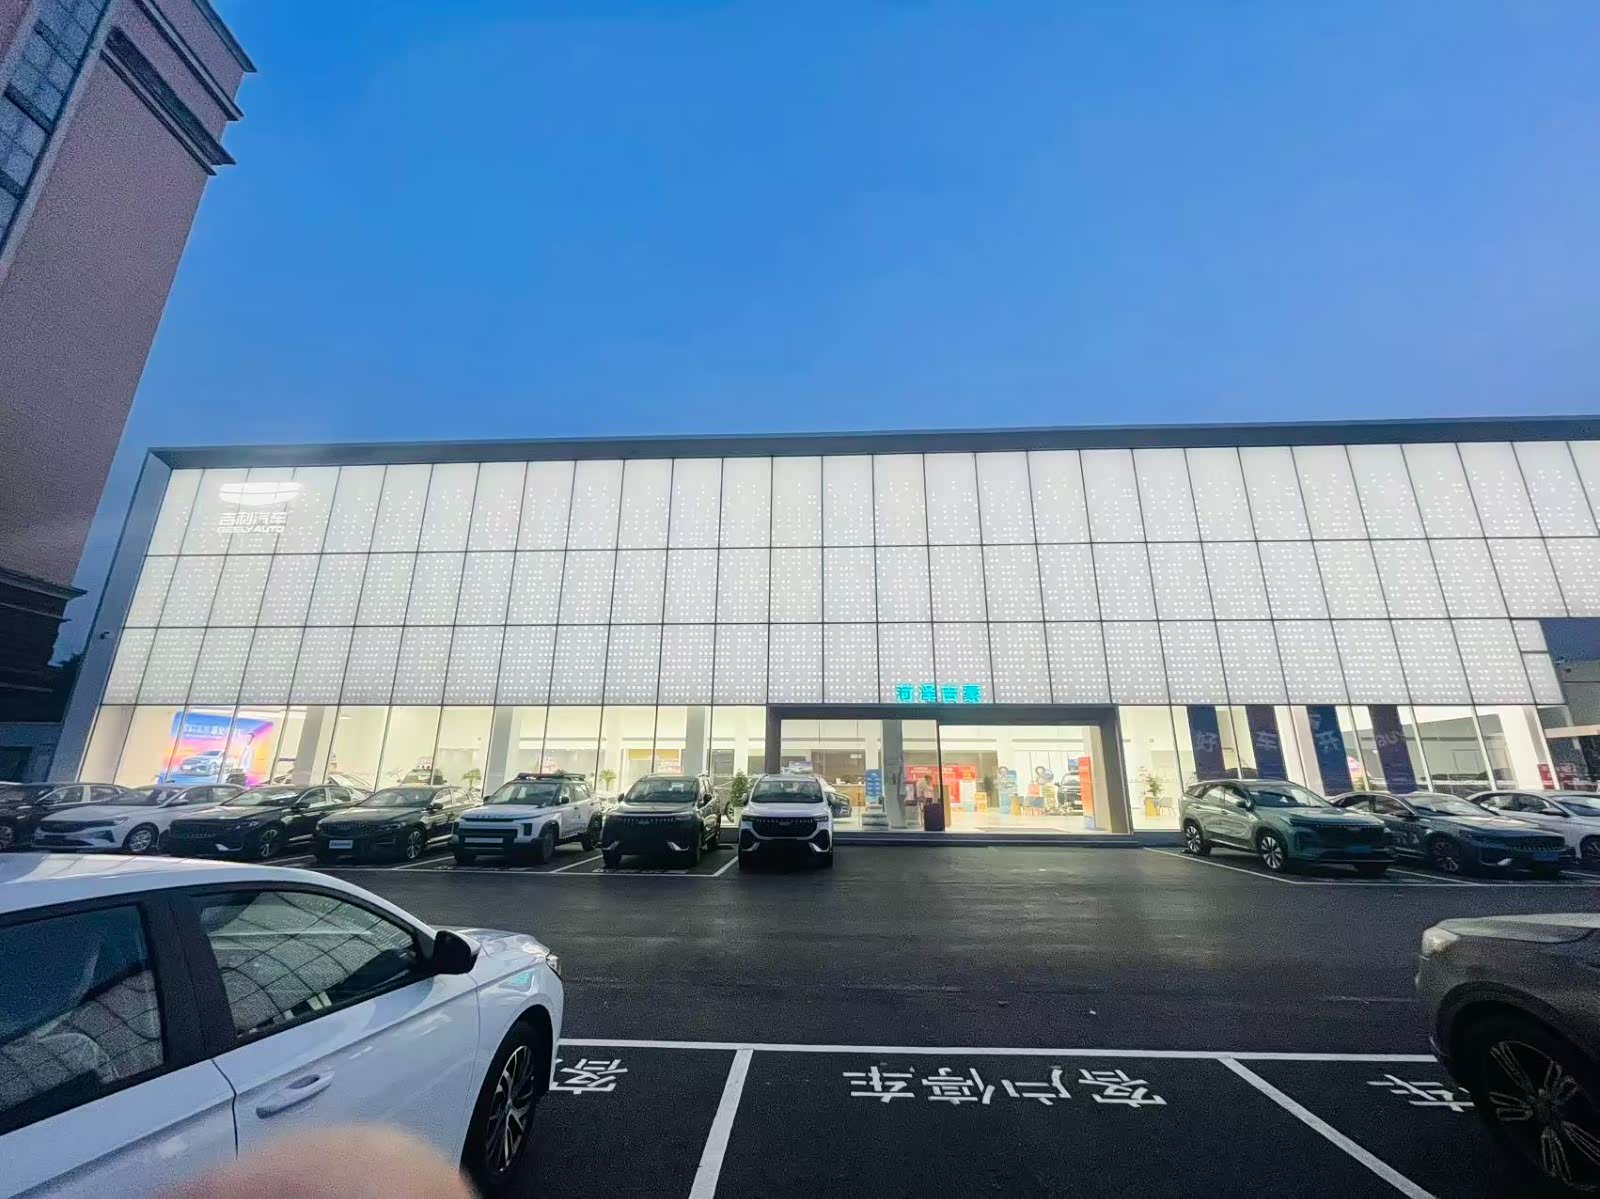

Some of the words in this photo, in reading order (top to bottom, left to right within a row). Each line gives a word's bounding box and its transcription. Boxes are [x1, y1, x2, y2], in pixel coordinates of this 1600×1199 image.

[219, 511, 288, 525] 吉利汽车
[252, 525, 285, 533] AUTO
[549, 1058, 628, 1094] 客
[842, 1065, 1167, 1108] 客户停车
[1366, 1073, 1476, 1113] 车
